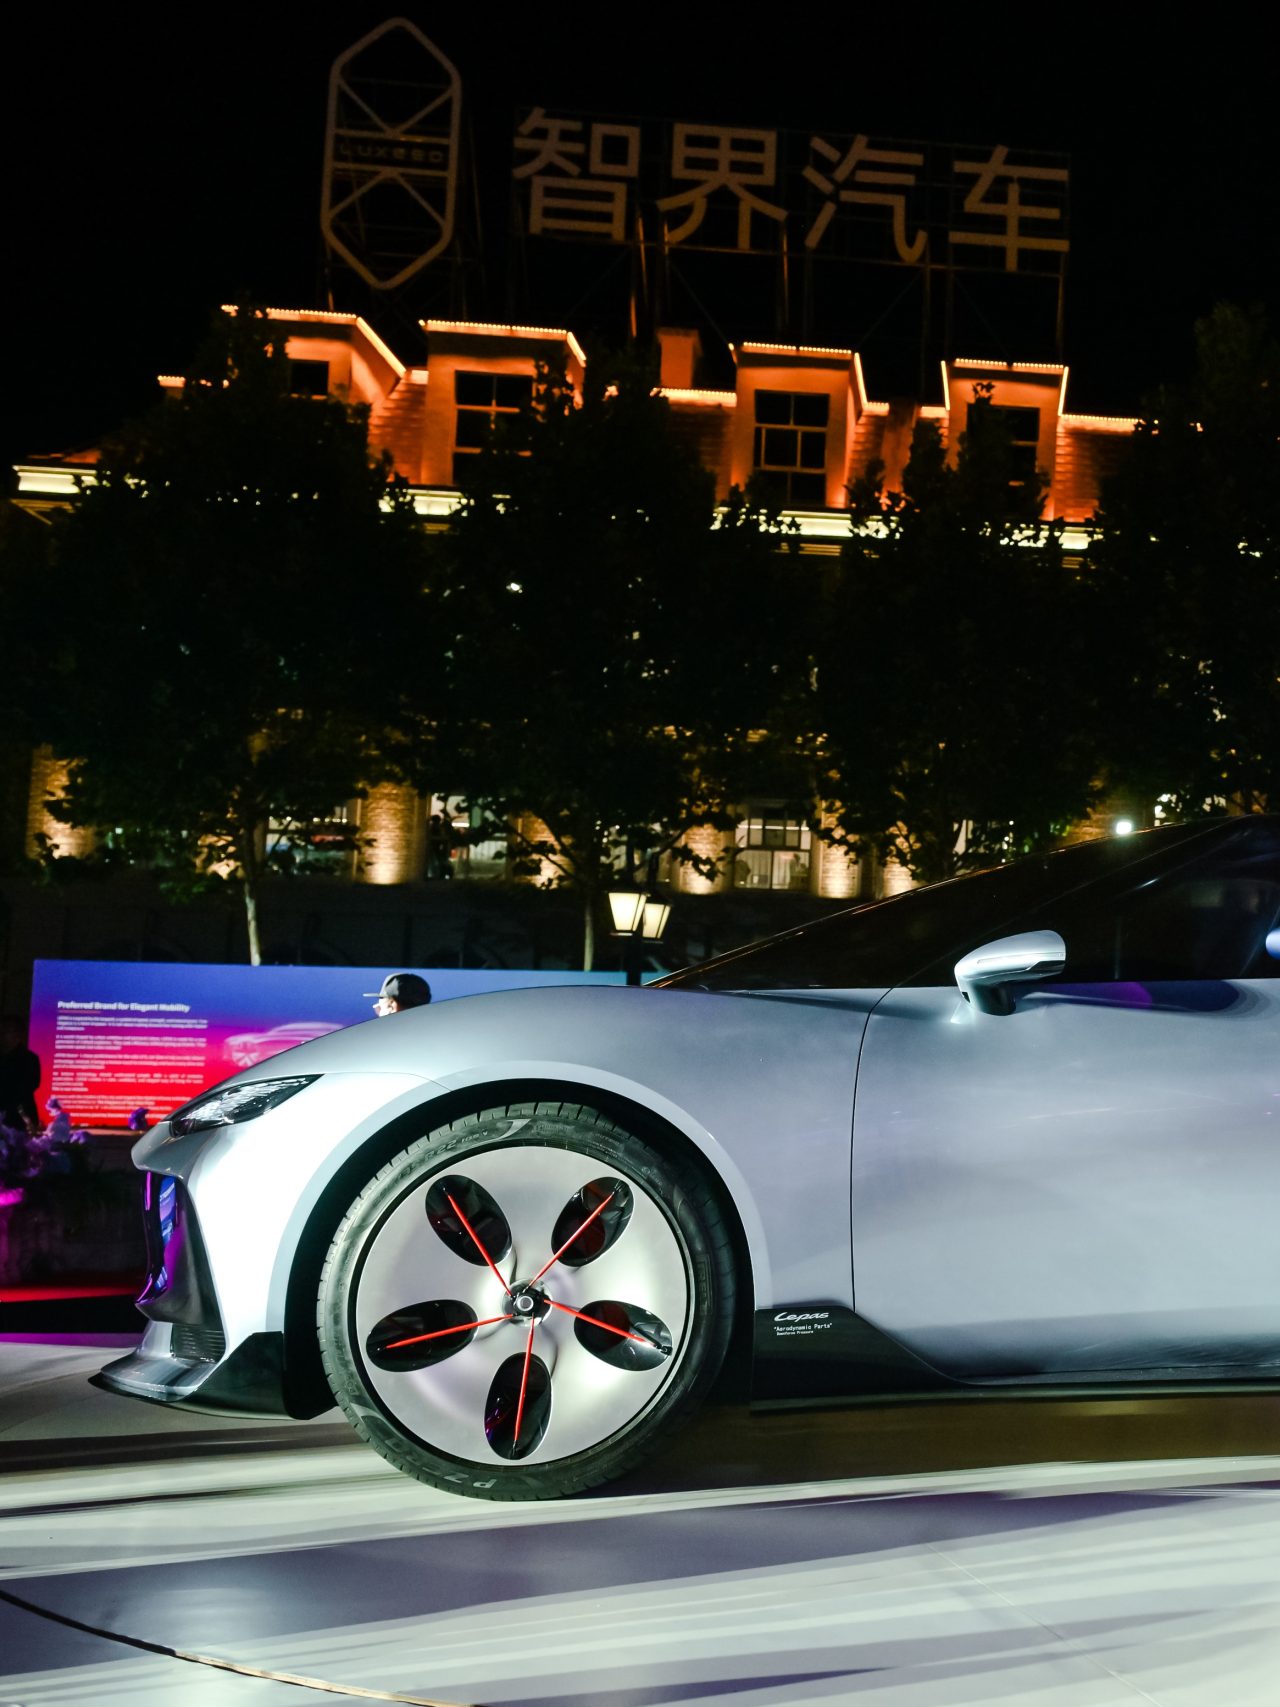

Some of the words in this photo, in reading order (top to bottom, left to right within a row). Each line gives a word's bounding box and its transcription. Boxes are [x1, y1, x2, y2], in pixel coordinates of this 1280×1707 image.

[512, 107, 1070, 271] 智界汽车
[57, 1001, 93, 1009] Preferred
[94, 1002, 117, 1010] Brand
[118, 1002, 129, 1010] for
[130, 1002, 158, 1012] Elegant
[159, 1003, 191, 1013] Mobility
[774, 1311, 829, 1322] Lepas
